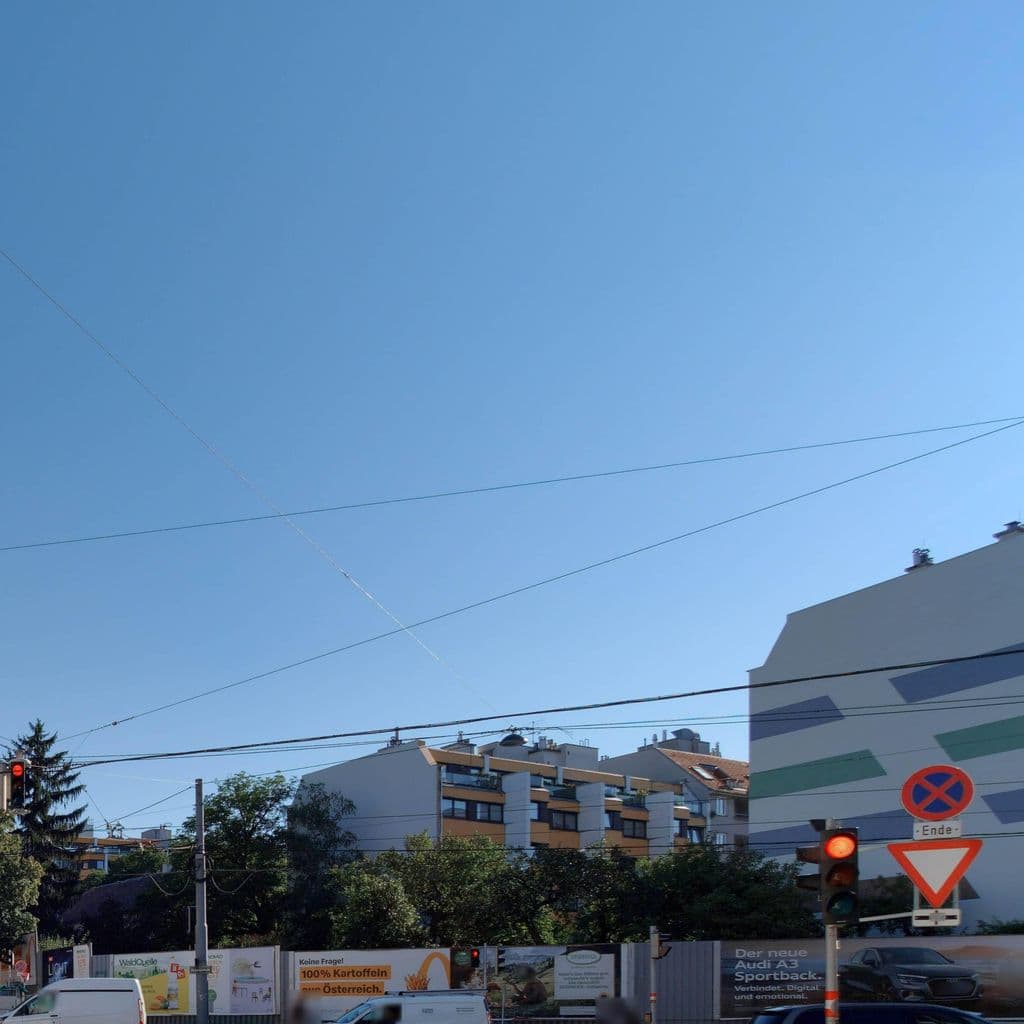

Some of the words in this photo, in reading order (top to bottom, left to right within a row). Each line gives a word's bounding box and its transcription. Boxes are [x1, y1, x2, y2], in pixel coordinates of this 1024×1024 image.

[922, 825, 952, 835] Ende
[735, 948, 763, 958] Der
[767, 949, 808, 958] neue
[321, 958, 344, 966] Frage!
[734, 959, 771, 969] Audi
[776, 959, 800, 969] A3
[302, 969, 331, 979] 100%
[333, 968, 388, 978] Kartoffeln
[734, 971, 824, 983] Sportback.
[323, 983, 383, 994] Österreich.
